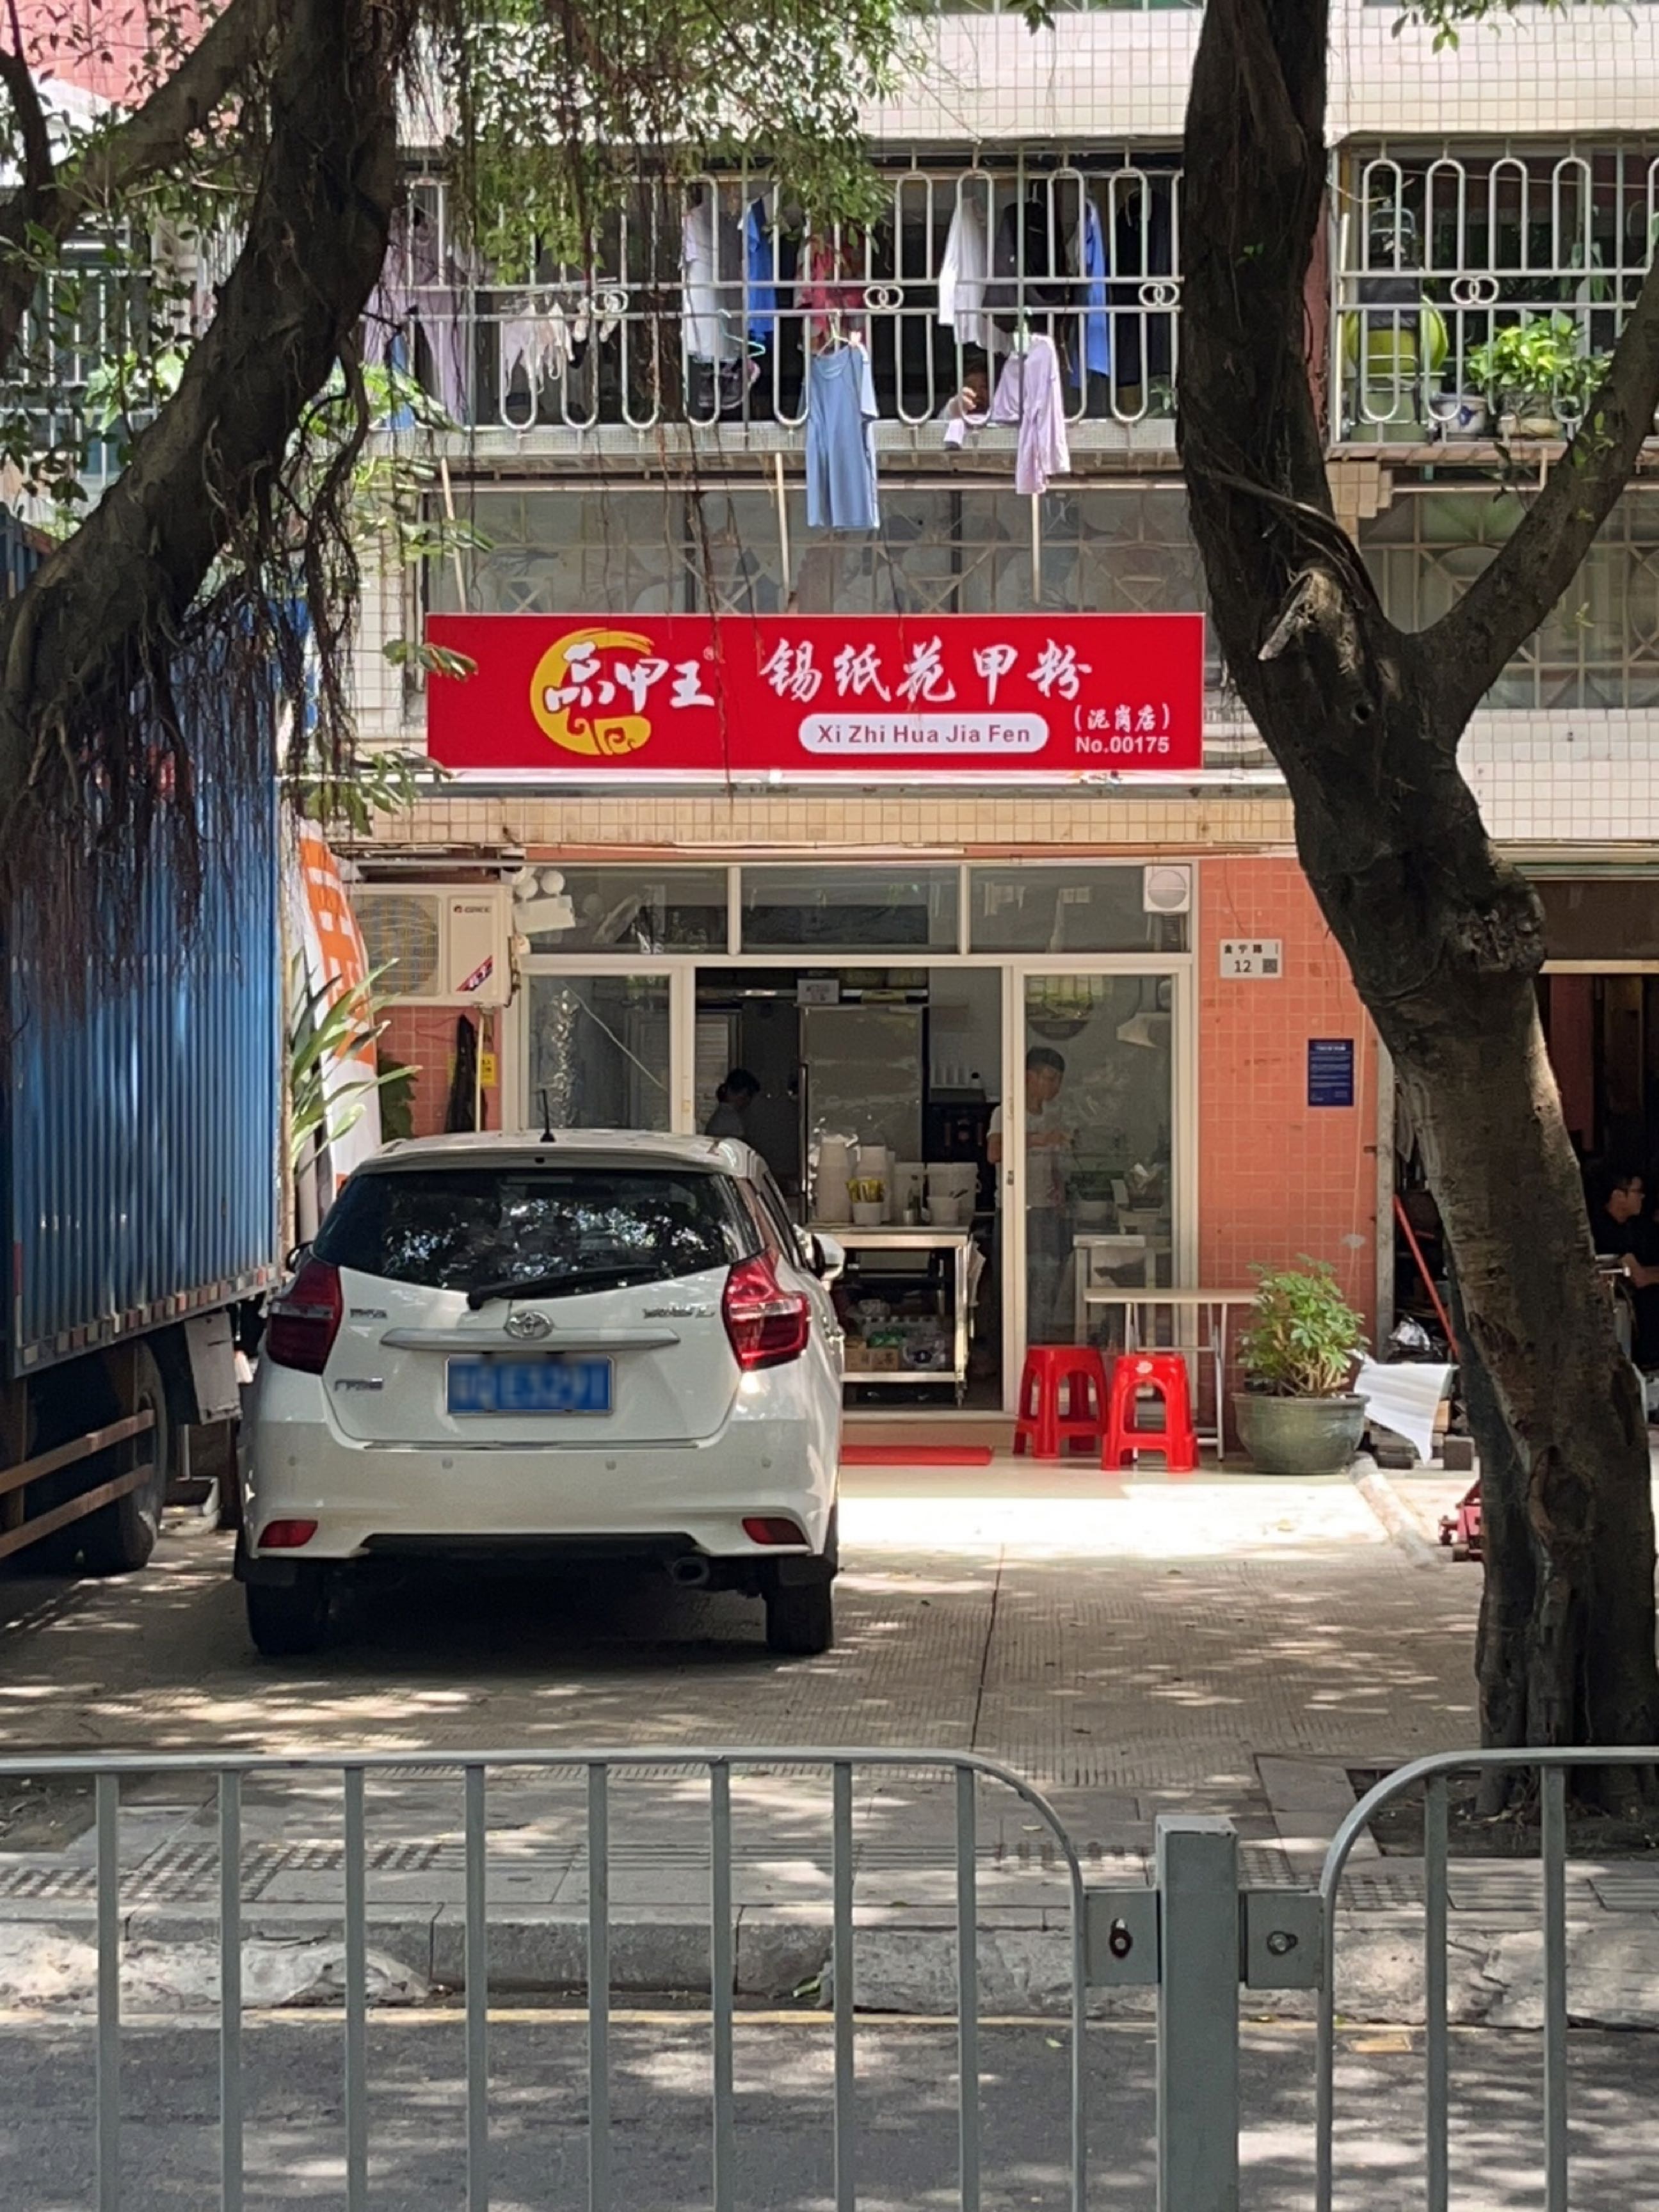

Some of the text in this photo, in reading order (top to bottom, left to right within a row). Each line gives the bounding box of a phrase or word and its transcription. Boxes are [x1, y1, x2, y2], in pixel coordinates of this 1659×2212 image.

[760, 636, 1092, 705] 锡纸花甲粉
[817, 724, 1030, 743] Xi Zhi Hua Jia Fen
[1075, 736, 1170, 753] No.00175
[1235, 960, 1252, 973] 12
